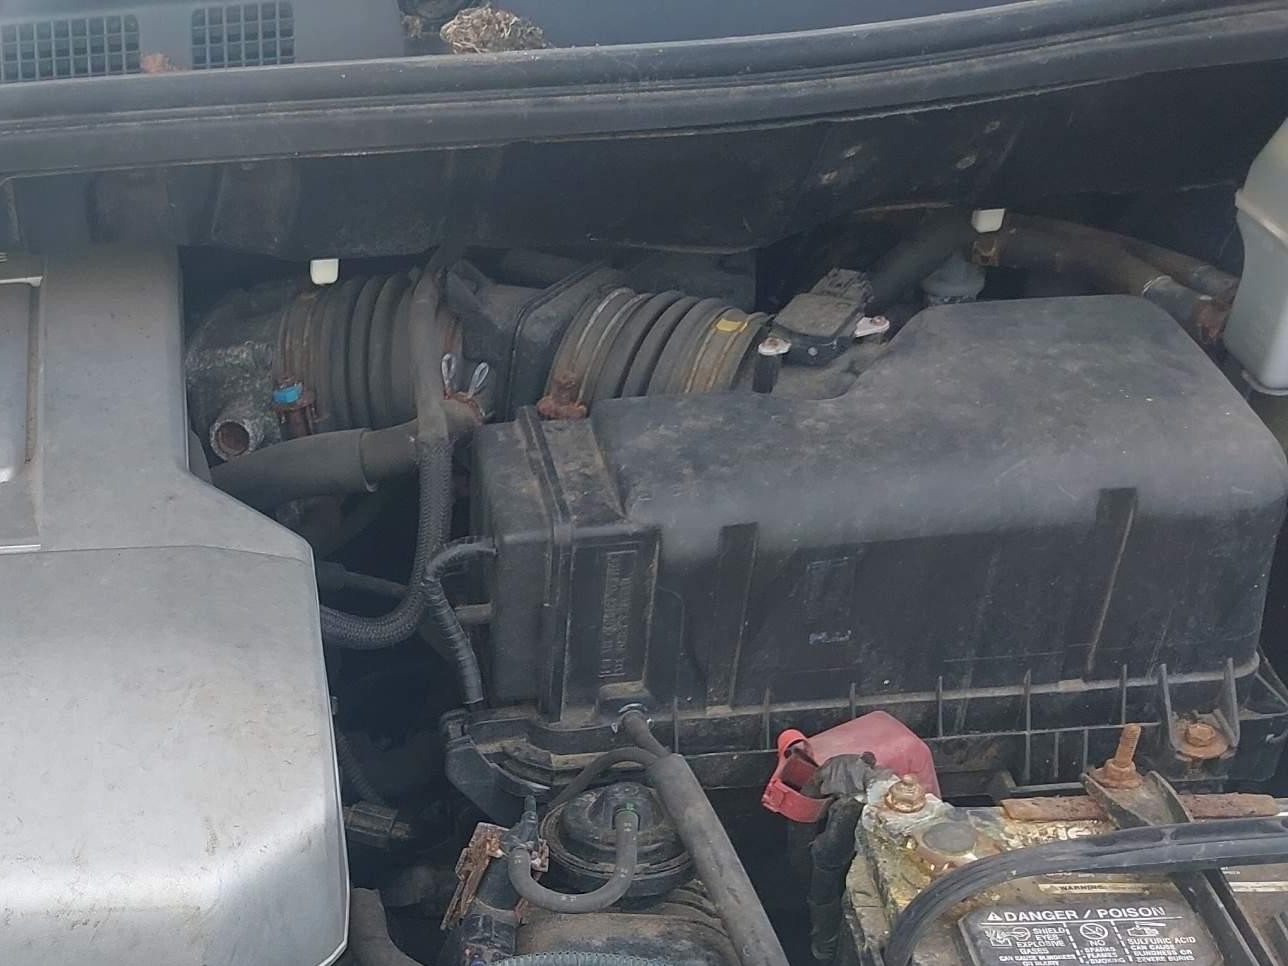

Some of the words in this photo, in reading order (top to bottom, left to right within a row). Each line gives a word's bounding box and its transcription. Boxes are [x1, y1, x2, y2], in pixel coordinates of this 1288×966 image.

[1004, 910, 1079, 921] DANGER
[1083, 909, 1091, 919] /
[1097, 906, 1166, 918] POISON
[1128, 937, 1172, 945] SULFURIC
